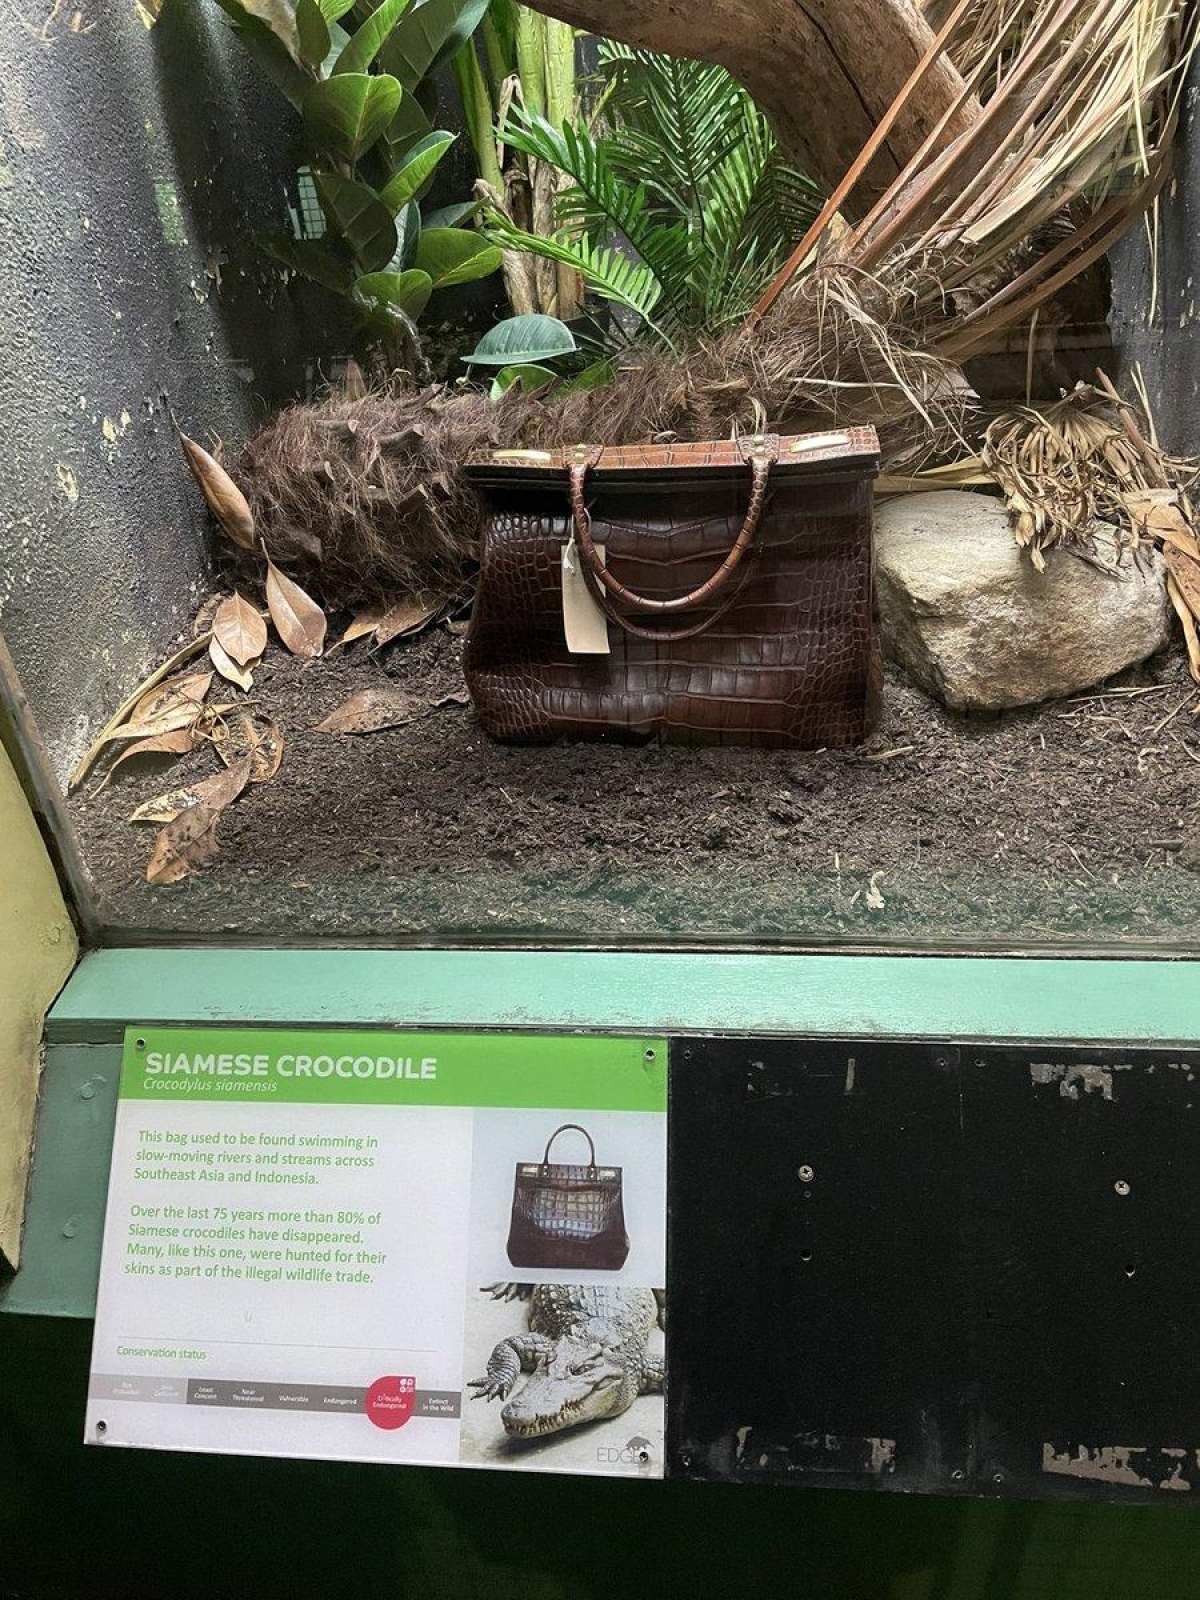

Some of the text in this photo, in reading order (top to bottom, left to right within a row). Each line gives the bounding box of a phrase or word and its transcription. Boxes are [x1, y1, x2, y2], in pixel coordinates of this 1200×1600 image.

[145, 1053, 437, 1080] SIAMESE CROCODILE
[143, 1077, 277, 1093] Crocodylus siamensis
[139, 1130, 378, 1150] This bag used to be found swimming in
[136, 1150, 374, 1166] slow-moving rivers and streams across
[134, 1168, 319, 1184] Southeast Asia and Indonesia.
[130, 1205, 381, 1224] Over the last 75 years more than 80% of
[128, 1224, 364, 1244] Siamese crocodiles have disappeared.
[127, 1242, 386, 1264] Many, like this one, were hunted for their
[124, 1262, 374, 1283] skins as part of the illegal wildlife trade.
[117, 1346, 206, 1359] Conservation status
